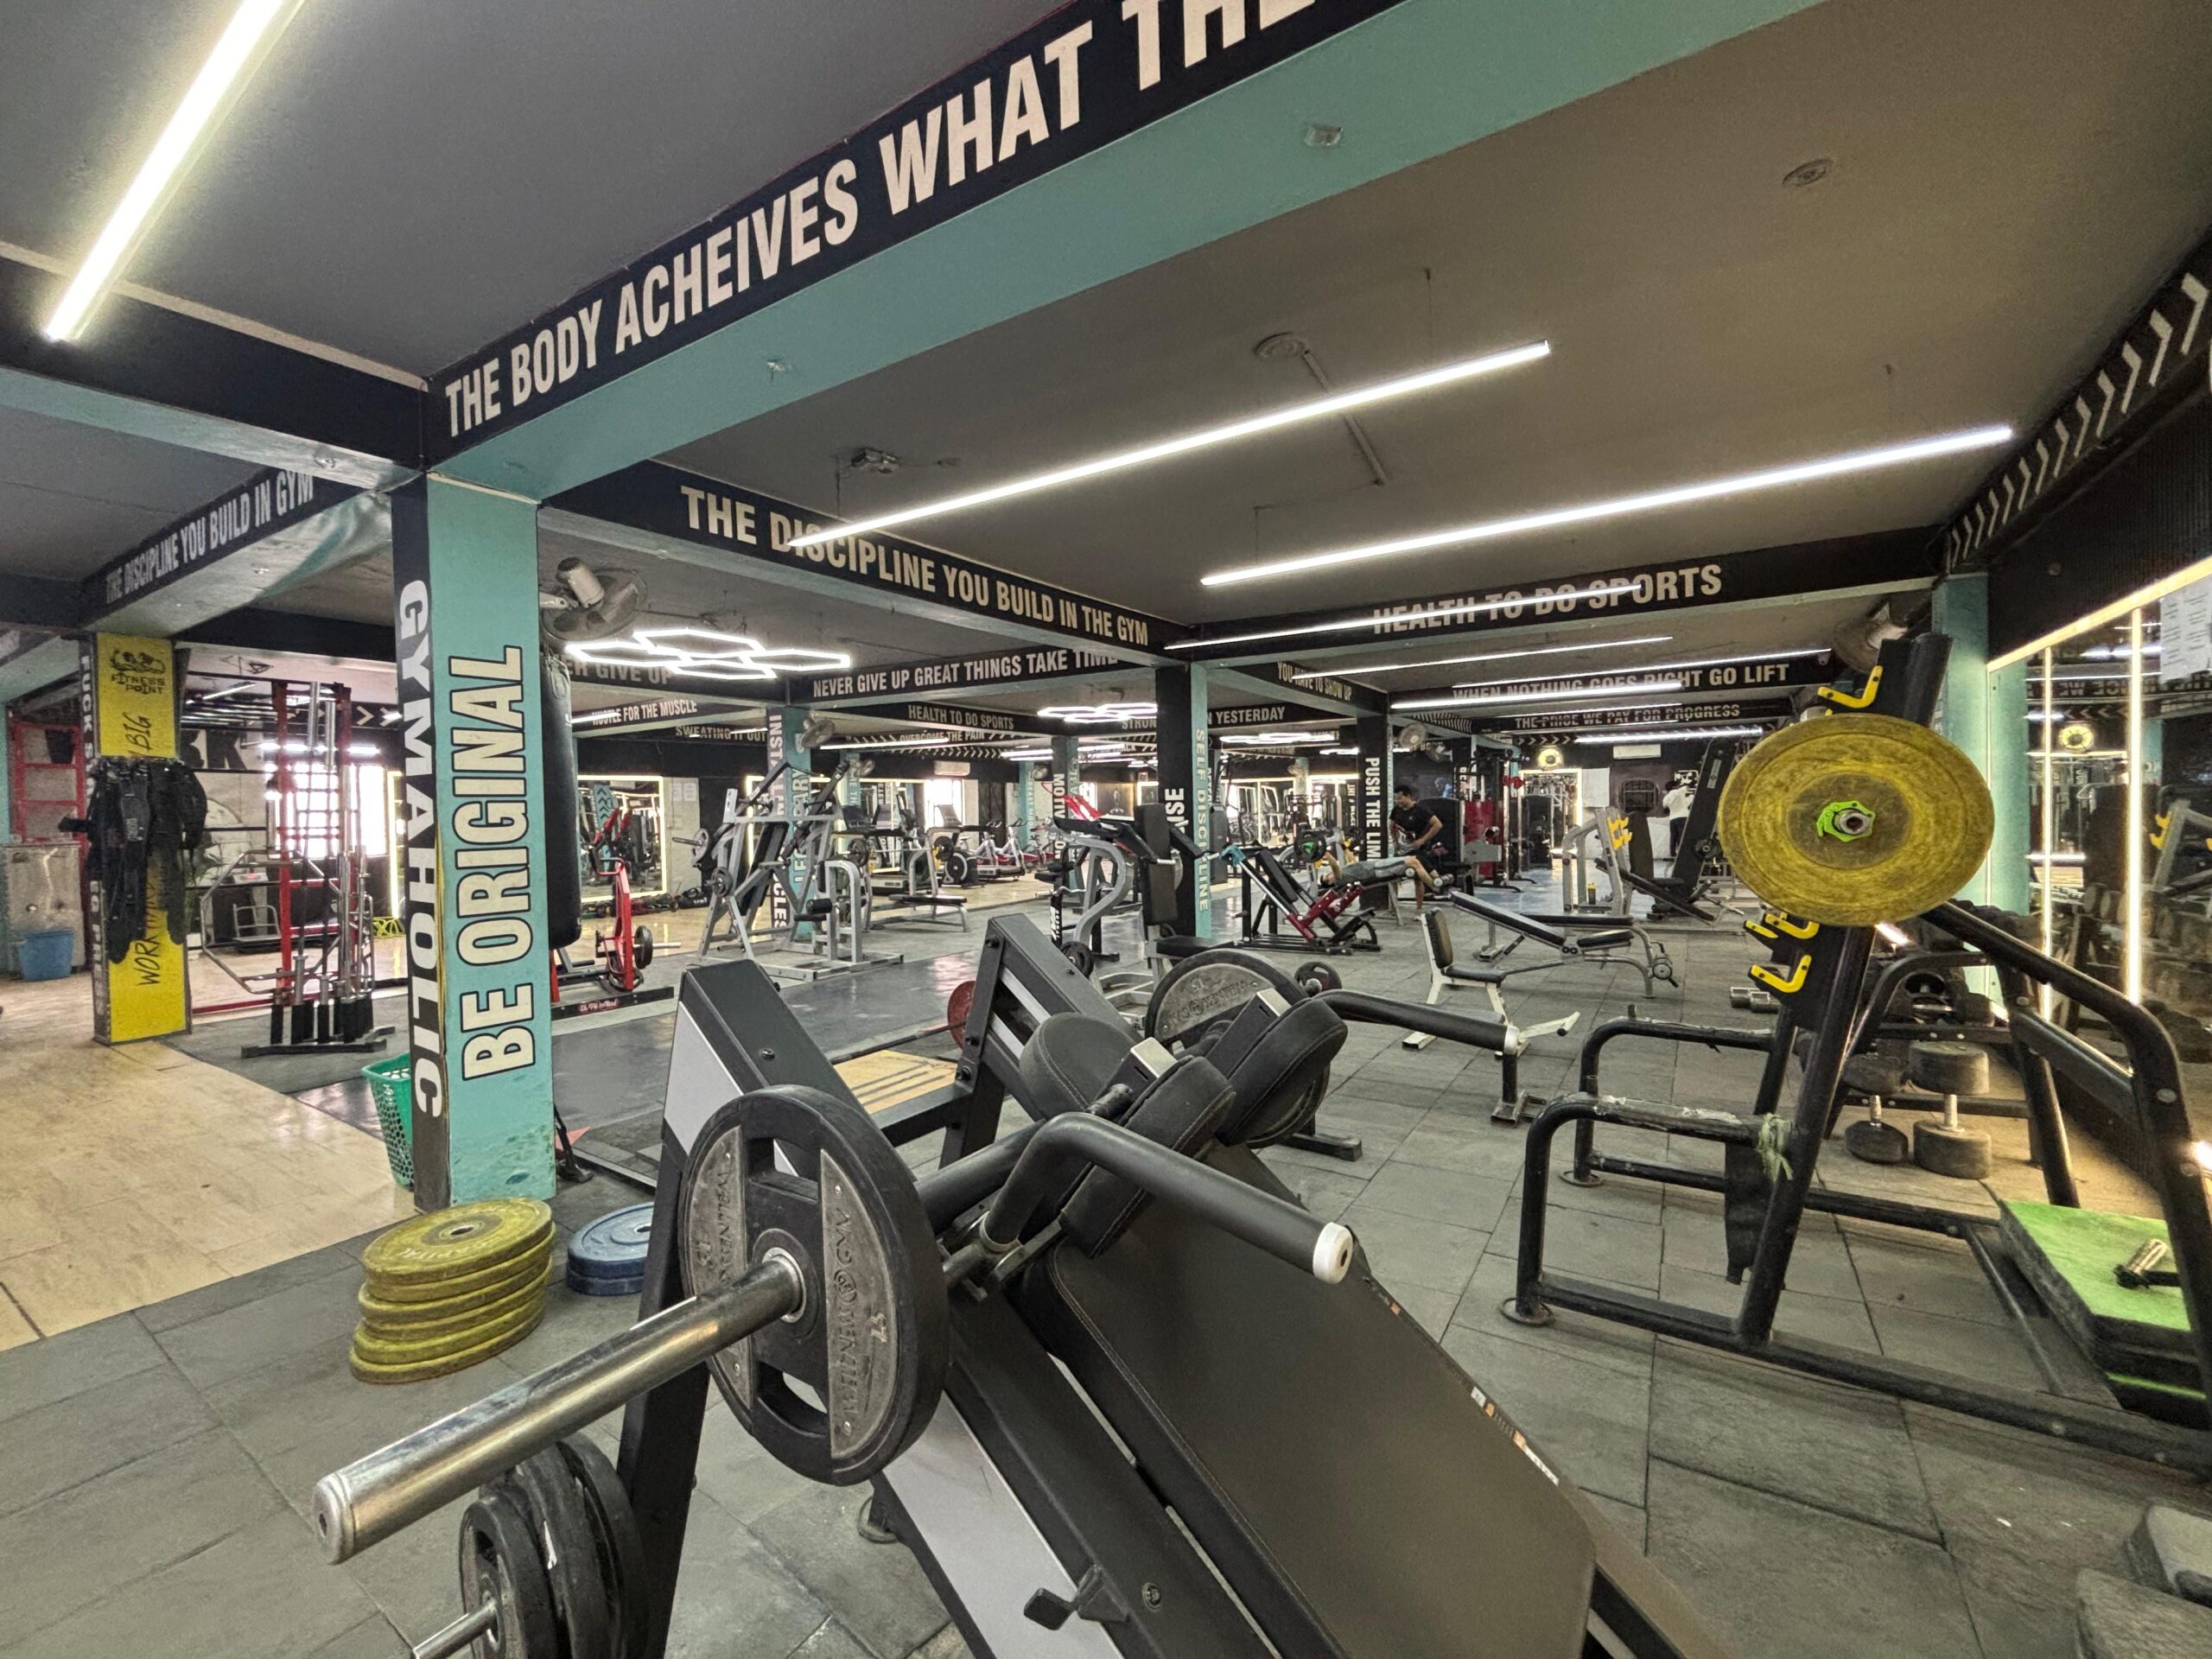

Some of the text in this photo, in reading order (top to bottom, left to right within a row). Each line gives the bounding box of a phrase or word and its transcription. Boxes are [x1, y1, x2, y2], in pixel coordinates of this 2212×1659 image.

[445, 357, 501, 438] THE
[512, 297, 603, 409] BODY
[613, 159, 859, 355] ACHEIVES
[879, 20, 1094, 216] WHAT
[180, 516, 207, 563] YOU
[209, 492, 251, 550] BUILD
[254, 479, 271, 528] IN
[276, 469, 315, 517] GYM
[681, 485, 1149, 646] THE DISCIPLINE YOU BUILD IN THE GYM
[1372, 563, 1722, 634] HEALTH TO DO SPORTS
[111, 673, 166, 695] FITNESS POINT
[595, 662, 642, 683] GIVE
[648, 666, 673, 684] UP
[813, 677, 853, 698] NEVER
[856, 671, 887, 693] GIVE
[892, 670, 910, 690] UP
[914, 664, 960, 686] GREAT
[963, 655, 1022, 682] THINGS
[1026, 649, 1068, 673] TAKE
[1277, 661, 1294, 683] YOU
[1315, 677, 1324, 693] TO
[1325, 677, 1343, 699] SHOW
[1344, 684, 1352, 702] UP
[1709, 668, 1738, 686] GO
[1745, 664, 1790, 683] LIFT
[623, 705, 640, 722] FOR
[641, 702, 658, 720] THE
[659, 699, 698, 717] MUSCLE
[907, 704, 1014, 730] HEALTH TO DO SPORTS
[1122, 716, 1156, 730] STRON
[1216, 707, 1286, 725] YESTERDAY
[1515, 717, 1536, 729] THE
[1583, 712, 1603, 725] WE
[1607, 711, 1630, 724] PAY
[1635, 709, 1662, 721] FOR
[1666, 704, 1741, 720] PROGRESS
[123, 712, 152, 752] BIG
[676, 726, 731, 741] SWEATING
[948, 731, 963, 741] THE
[1196, 728, 1206, 781] SELF
[1365, 757, 1382, 861] PUSH THE LIM
[399, 580, 442, 1118] GYMAHOLIC
[448, 645, 536, 1081] BE ORIGINAL
